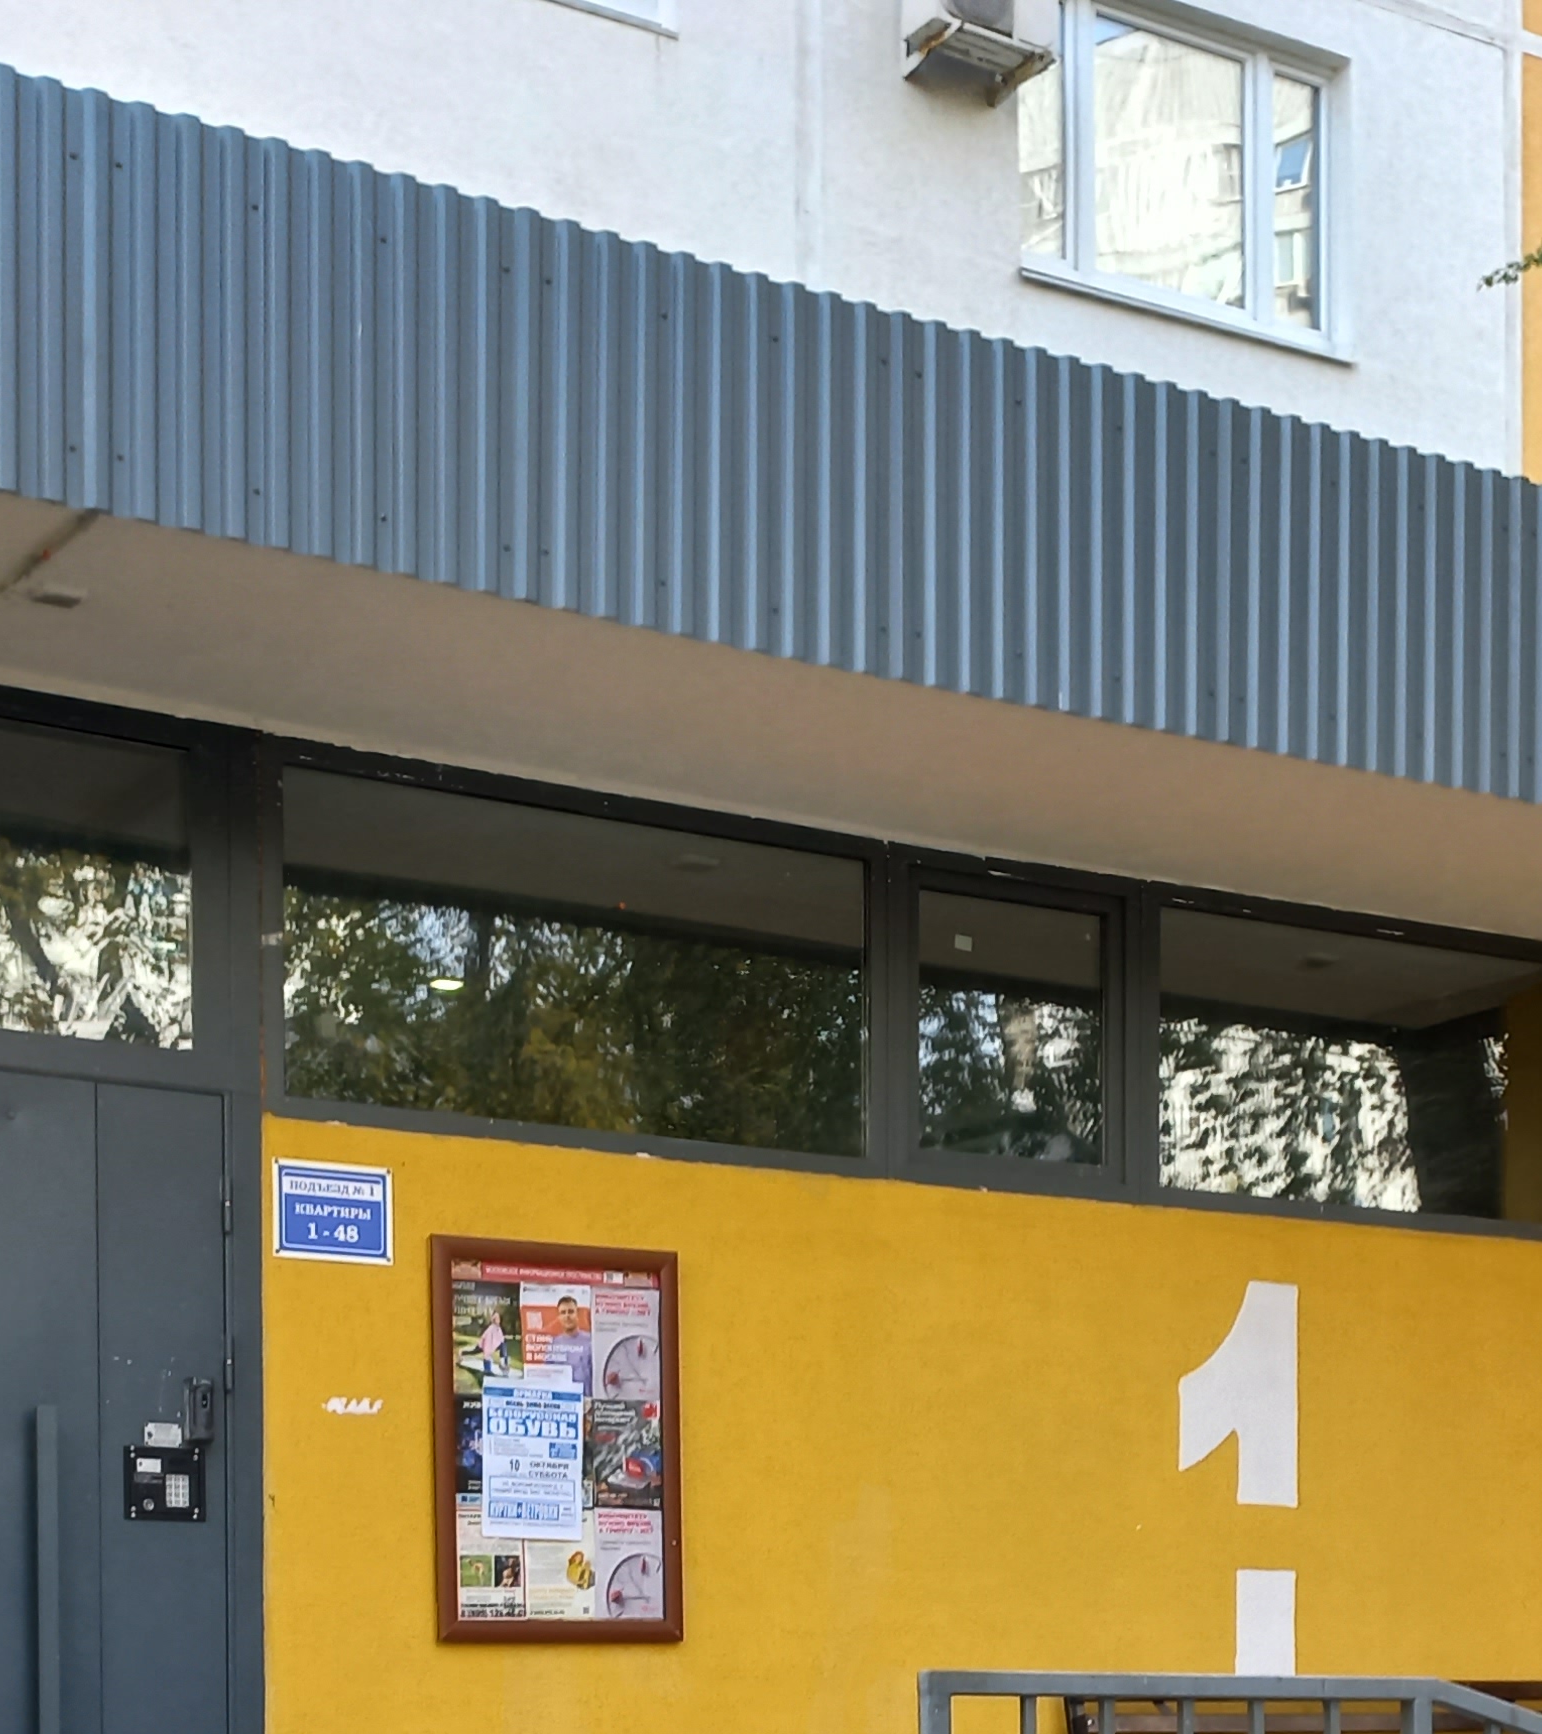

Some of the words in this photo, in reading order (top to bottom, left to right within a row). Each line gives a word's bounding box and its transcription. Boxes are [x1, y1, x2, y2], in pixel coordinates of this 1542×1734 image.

[289, 1179, 350, 1197] ПОДЪЕЗД
[369, 1185, 375, 1197] 1
[294, 1202, 372, 1221] КВАРТИРЫ
[307, 1222, 319, 1240] 1
[333, 1224, 360, 1243] 48
[489, 1418, 577, 1440] ОБУВЬ
[509, 1458, 521, 1473] 10
